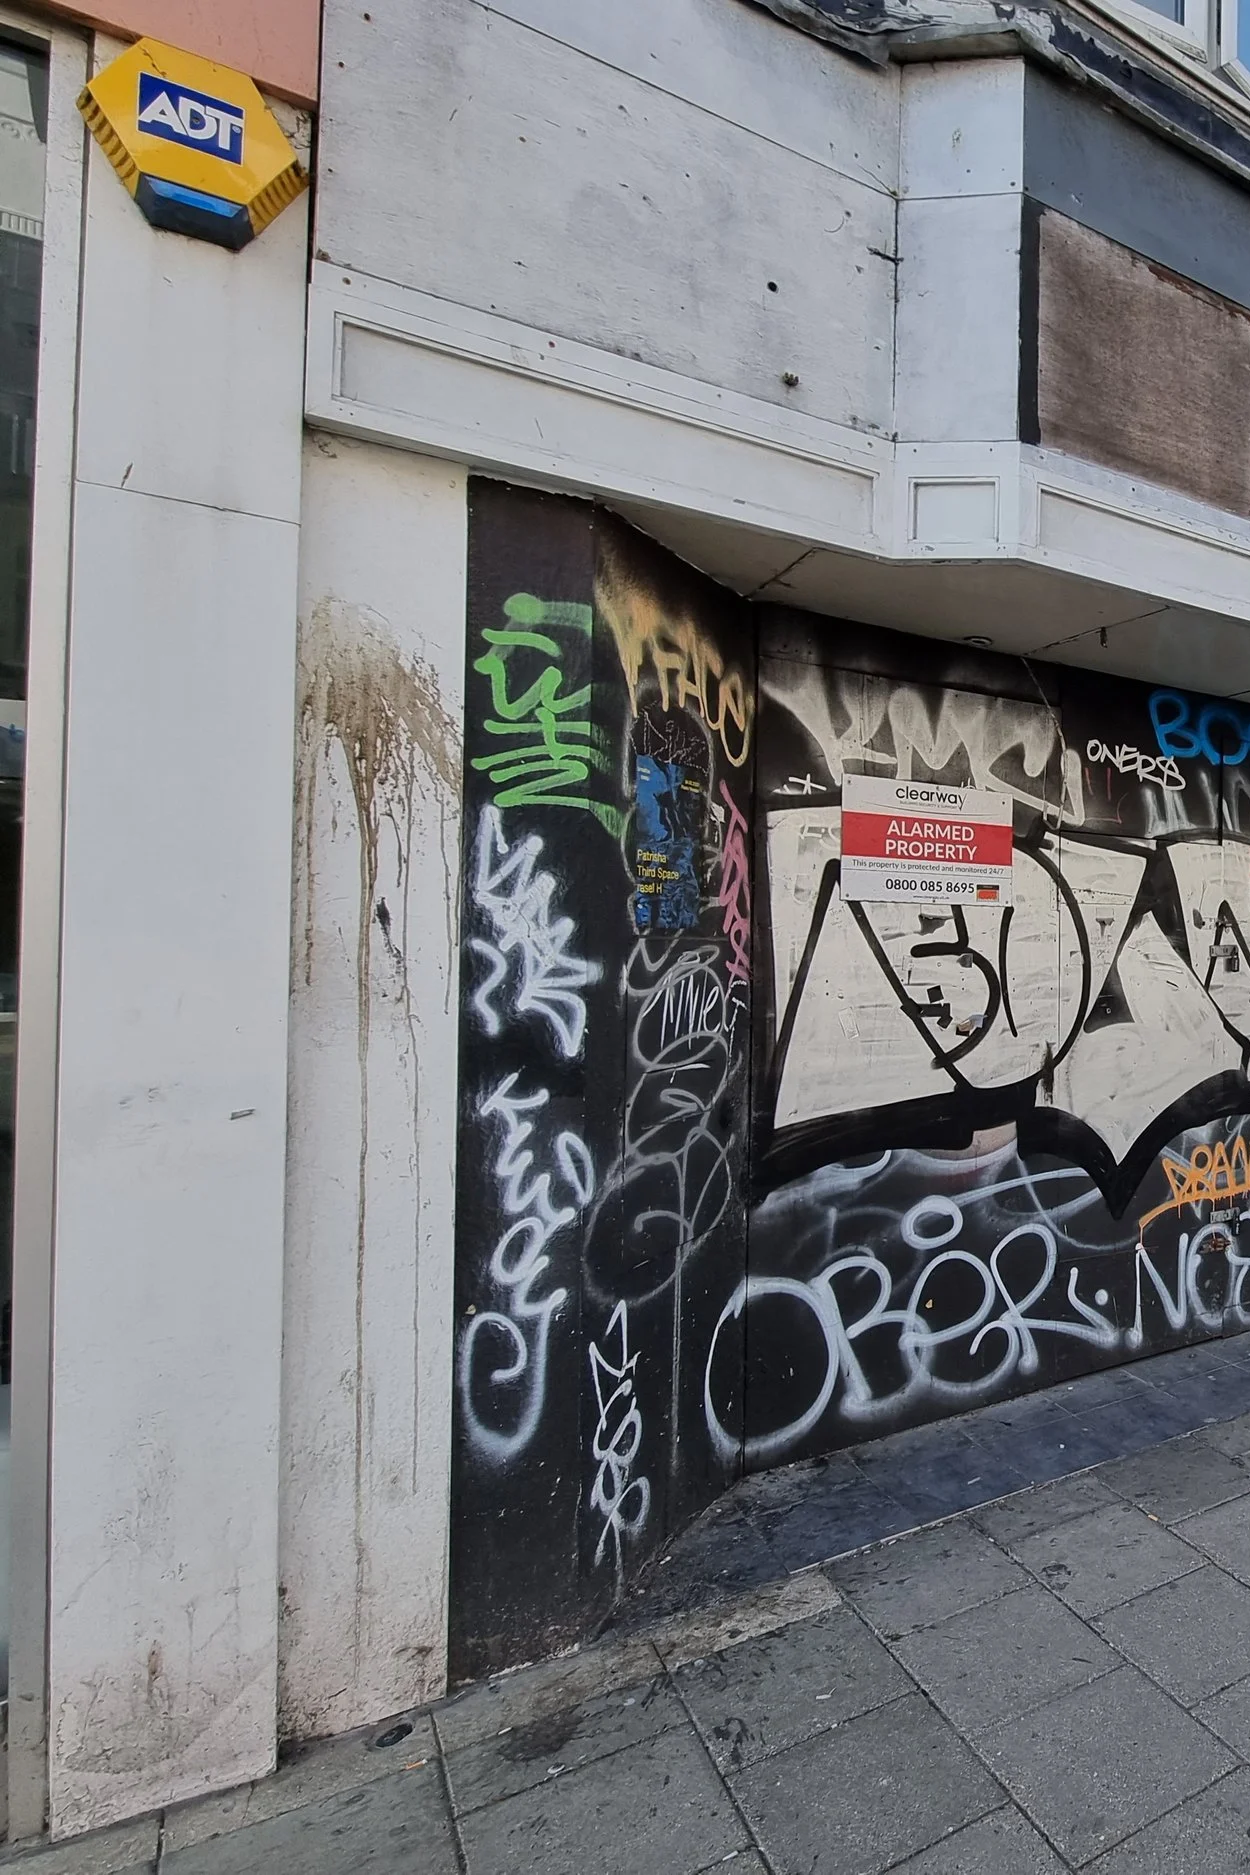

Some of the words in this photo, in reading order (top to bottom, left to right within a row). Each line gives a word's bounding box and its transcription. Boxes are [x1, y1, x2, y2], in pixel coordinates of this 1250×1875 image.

[139, 91, 244, 151] ADT
[896, 785, 968, 812] clearway
[886, 820, 975, 842] ALARMED
[637, 848, 667, 864] Patrisha
[885, 839, 978, 861] PROPERTY
[636, 864, 656, 877] Third
[657, 867, 680, 881] Space
[852, 859, 868, 868] This
[868, 861, 900, 872] property
[907, 863, 940, 873] protected
[955, 866, 988, 875] monitored
[885, 878, 917, 891] 0800
[920, 880, 943, 892] 085
[945, 882, 975, 894] 8695
